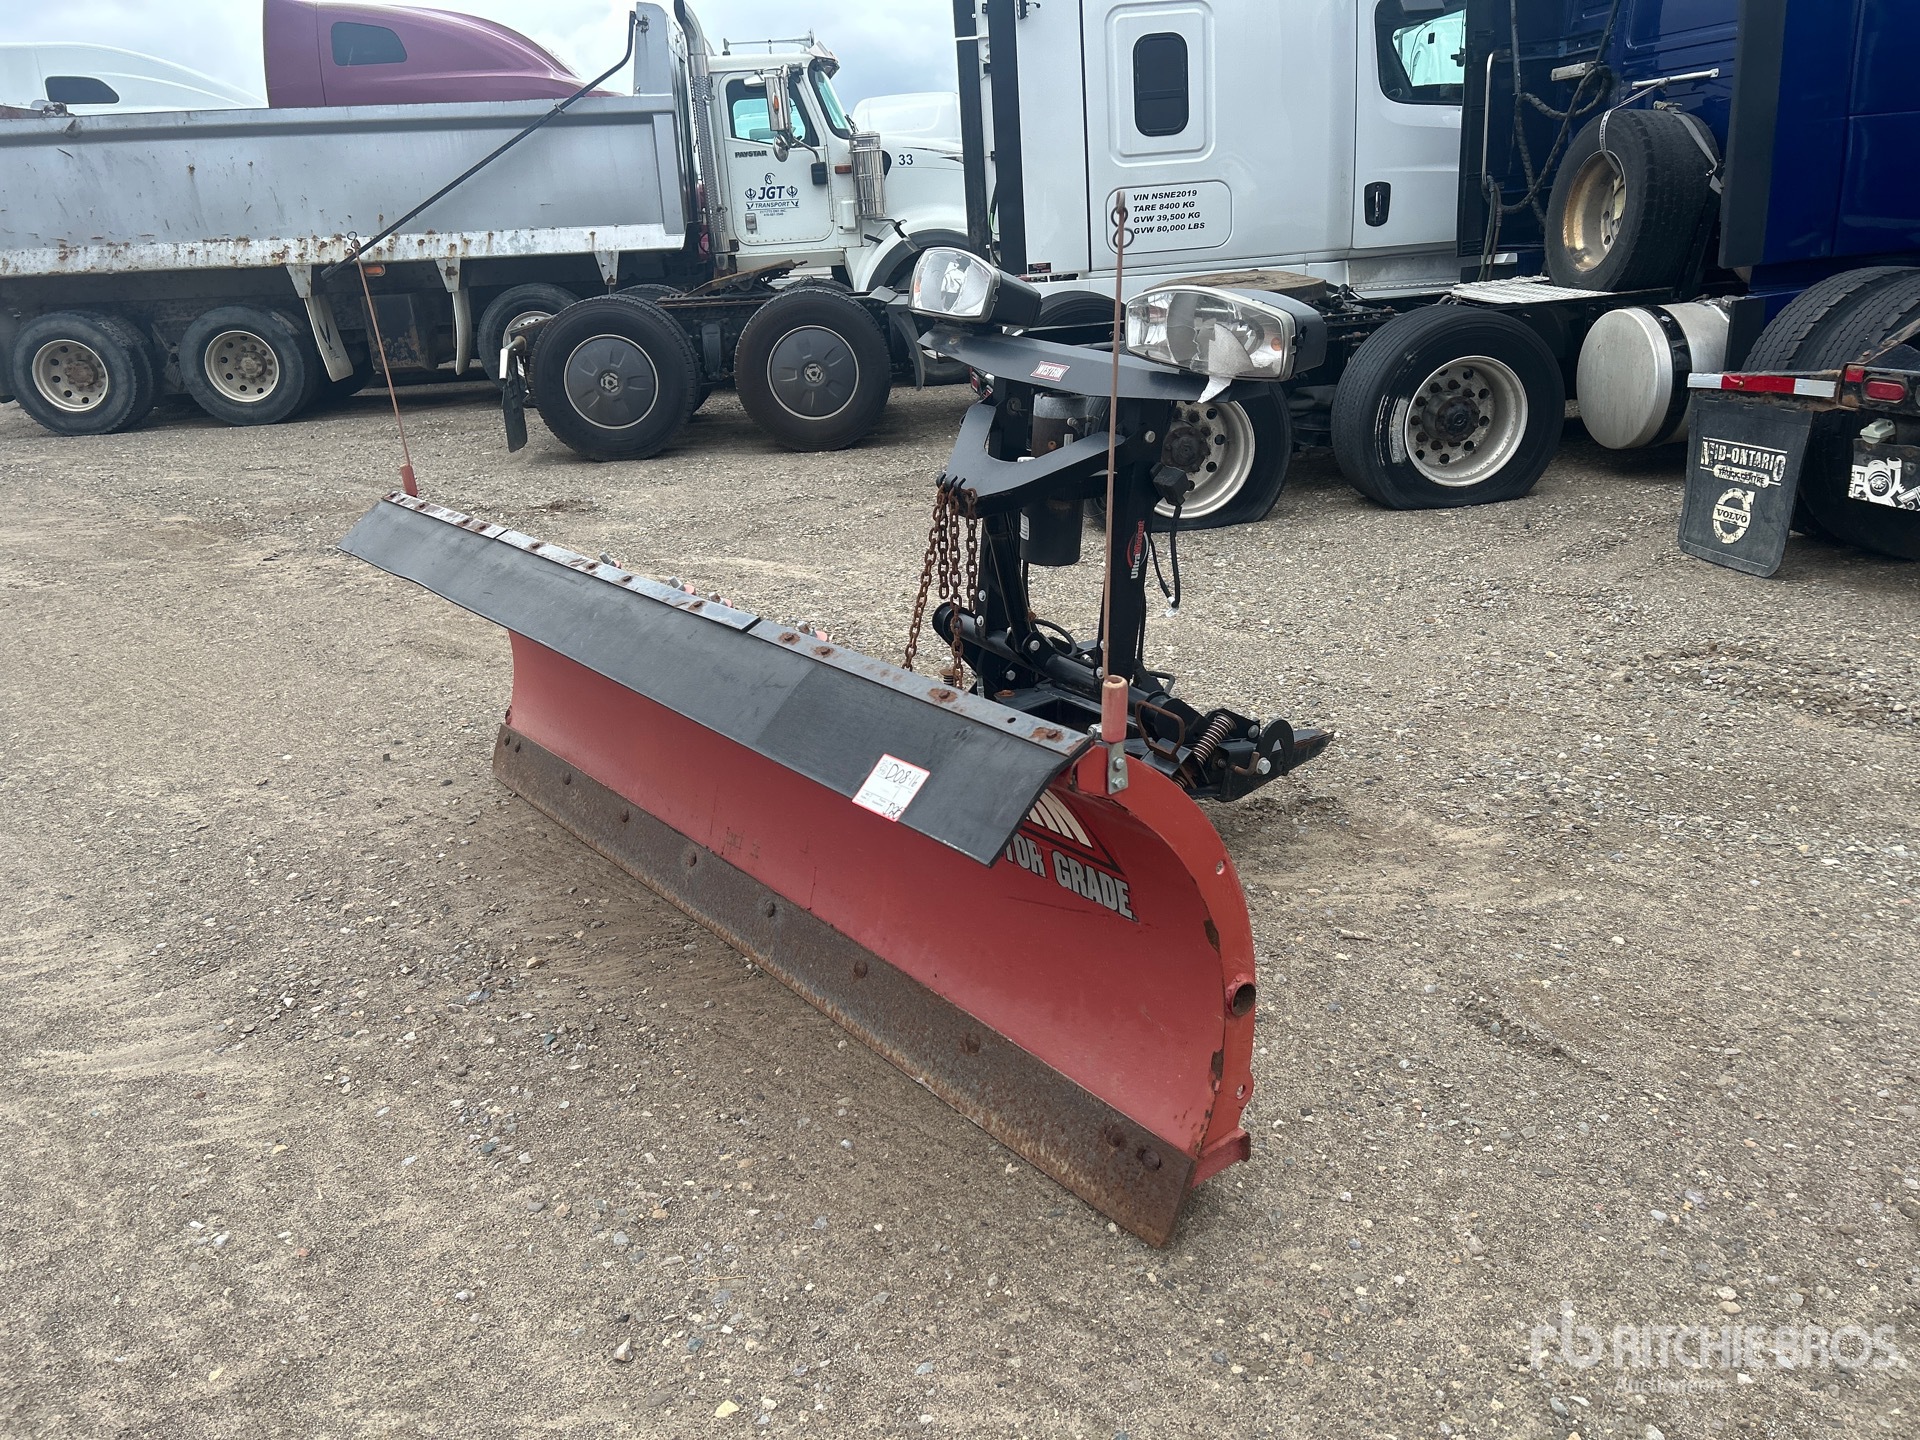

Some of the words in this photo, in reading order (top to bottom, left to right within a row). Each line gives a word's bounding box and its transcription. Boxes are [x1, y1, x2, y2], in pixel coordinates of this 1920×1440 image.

[734, 150, 768, 158] PAYSTAR
[898, 153, 914, 166] 33
[758, 185, 785, 200] JGT
[1151, 190, 1197, 200] NSNE2019
[1134, 204, 1156, 212] TARE
[1158, 202, 1180, 210] 8400
[1134, 215, 1154, 223] GVW
[1156, 213, 1185, 222] 39,500
[1188, 211, 1200, 219] KG
[1134, 226, 1154, 234] GVW
[1156, 224, 1185, 233] 80,000
[1188, 222, 1205, 230] LBS
[1716, 508, 1748, 523] VOLVO
[1051, 849, 1134, 920] GRADE
